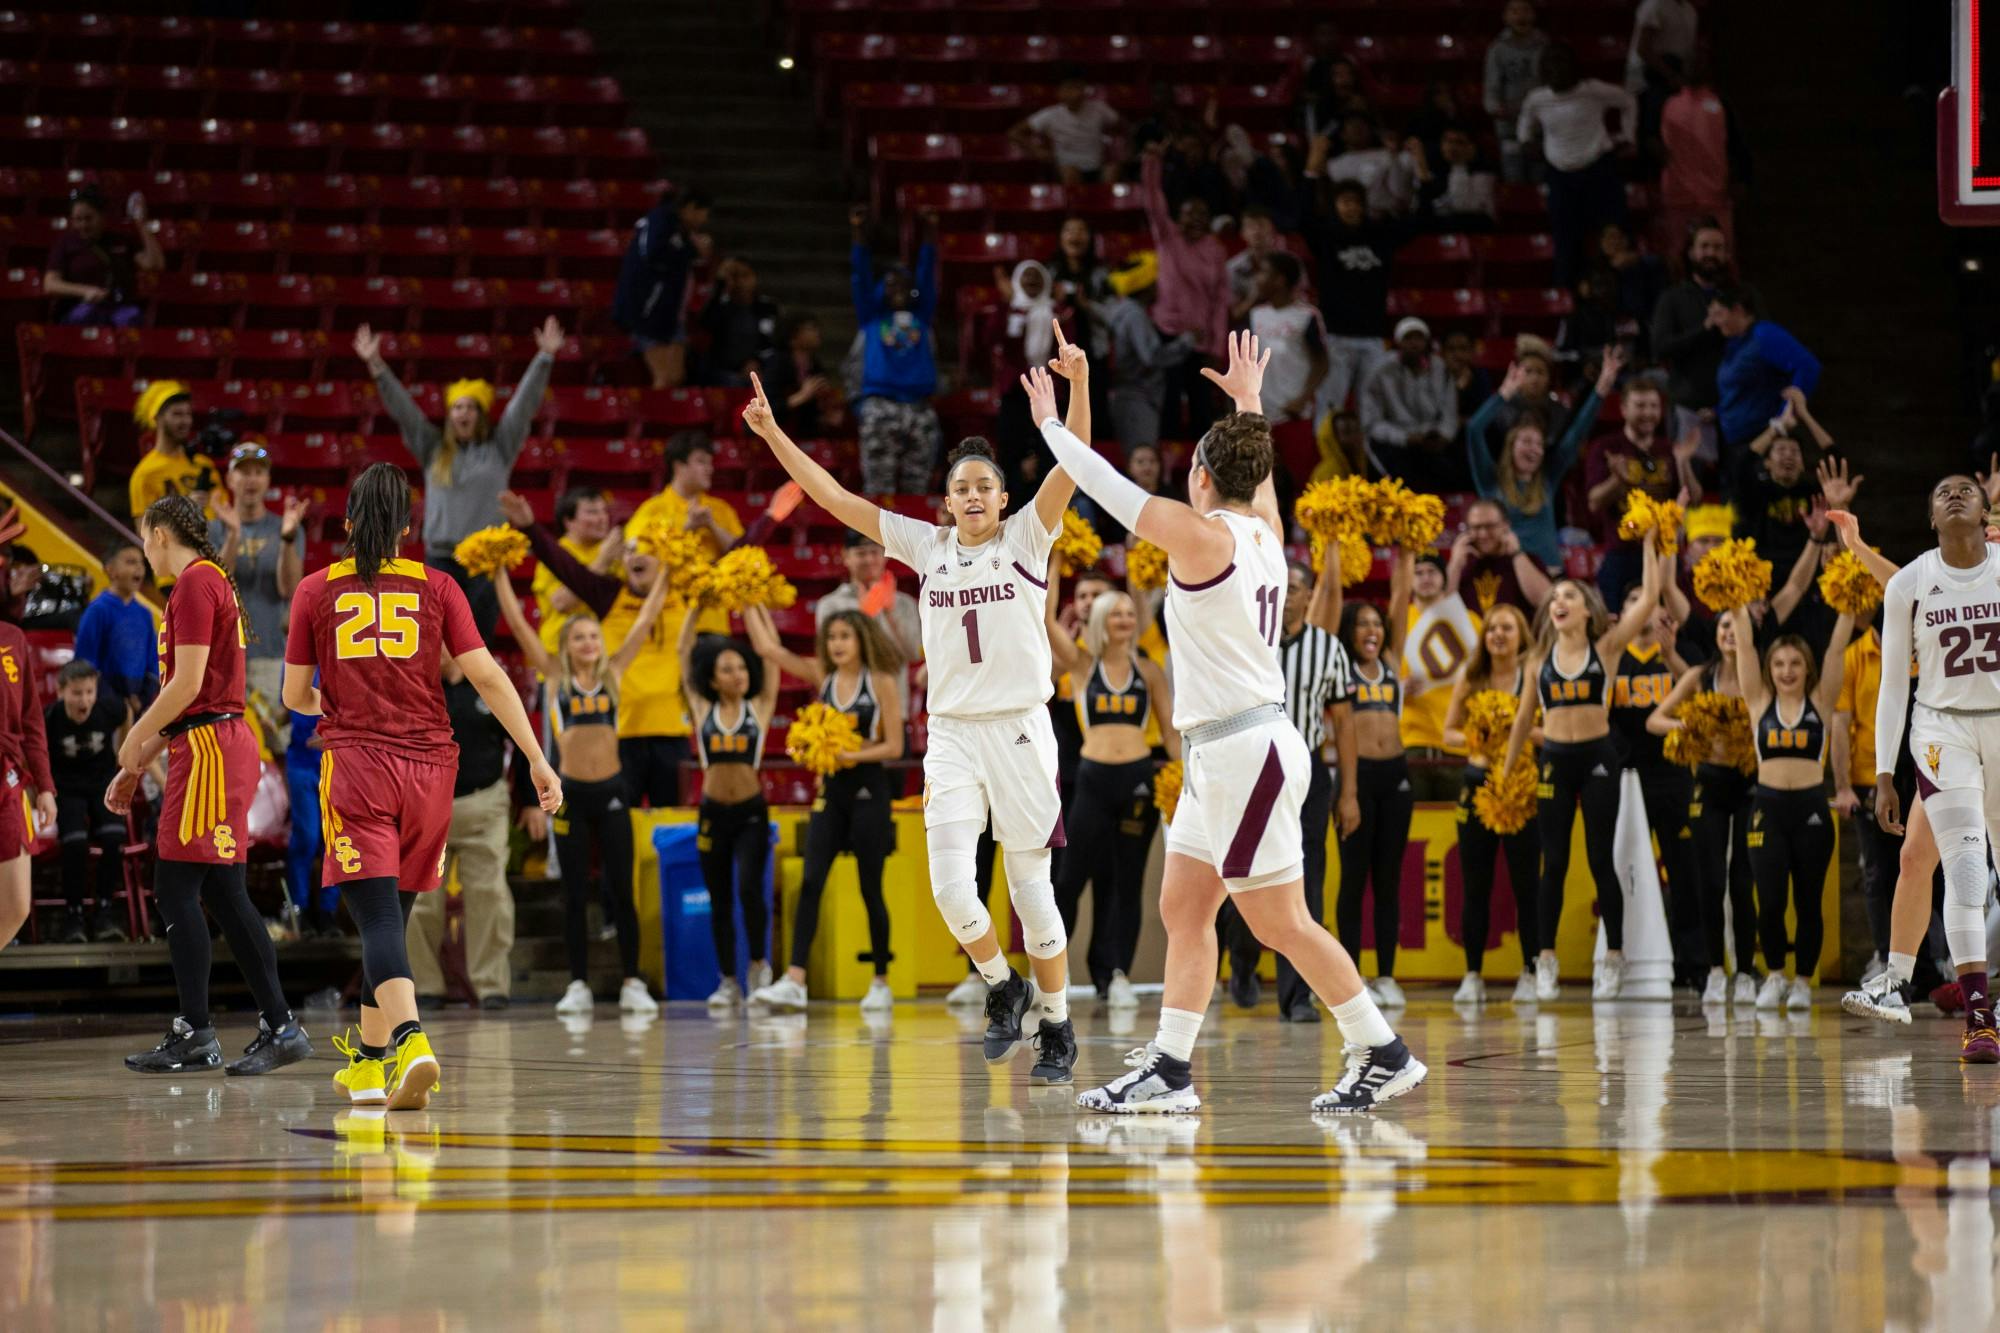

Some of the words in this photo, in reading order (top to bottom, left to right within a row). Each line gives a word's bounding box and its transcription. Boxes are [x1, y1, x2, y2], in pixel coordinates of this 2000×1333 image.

[929, 590, 954, 607] SUN
[959, 583, 1015, 606] DEVILS
[335, 592, 420, 659] 25
[1256, 585, 1279, 647] 11
[1925, 607, 1957, 627] SUN
[1962, 602, 2000, 621] DEVI
[961, 609, 982, 664] 1
[1939, 622, 2000, 677] 23
[1551, 680, 1590, 700] ASU
[1615, 674, 1673, 708] ASU
[1767, 729, 1808, 748] ASU
[213, 825, 236, 858] SC
[335, 836, 361, 873] SC
